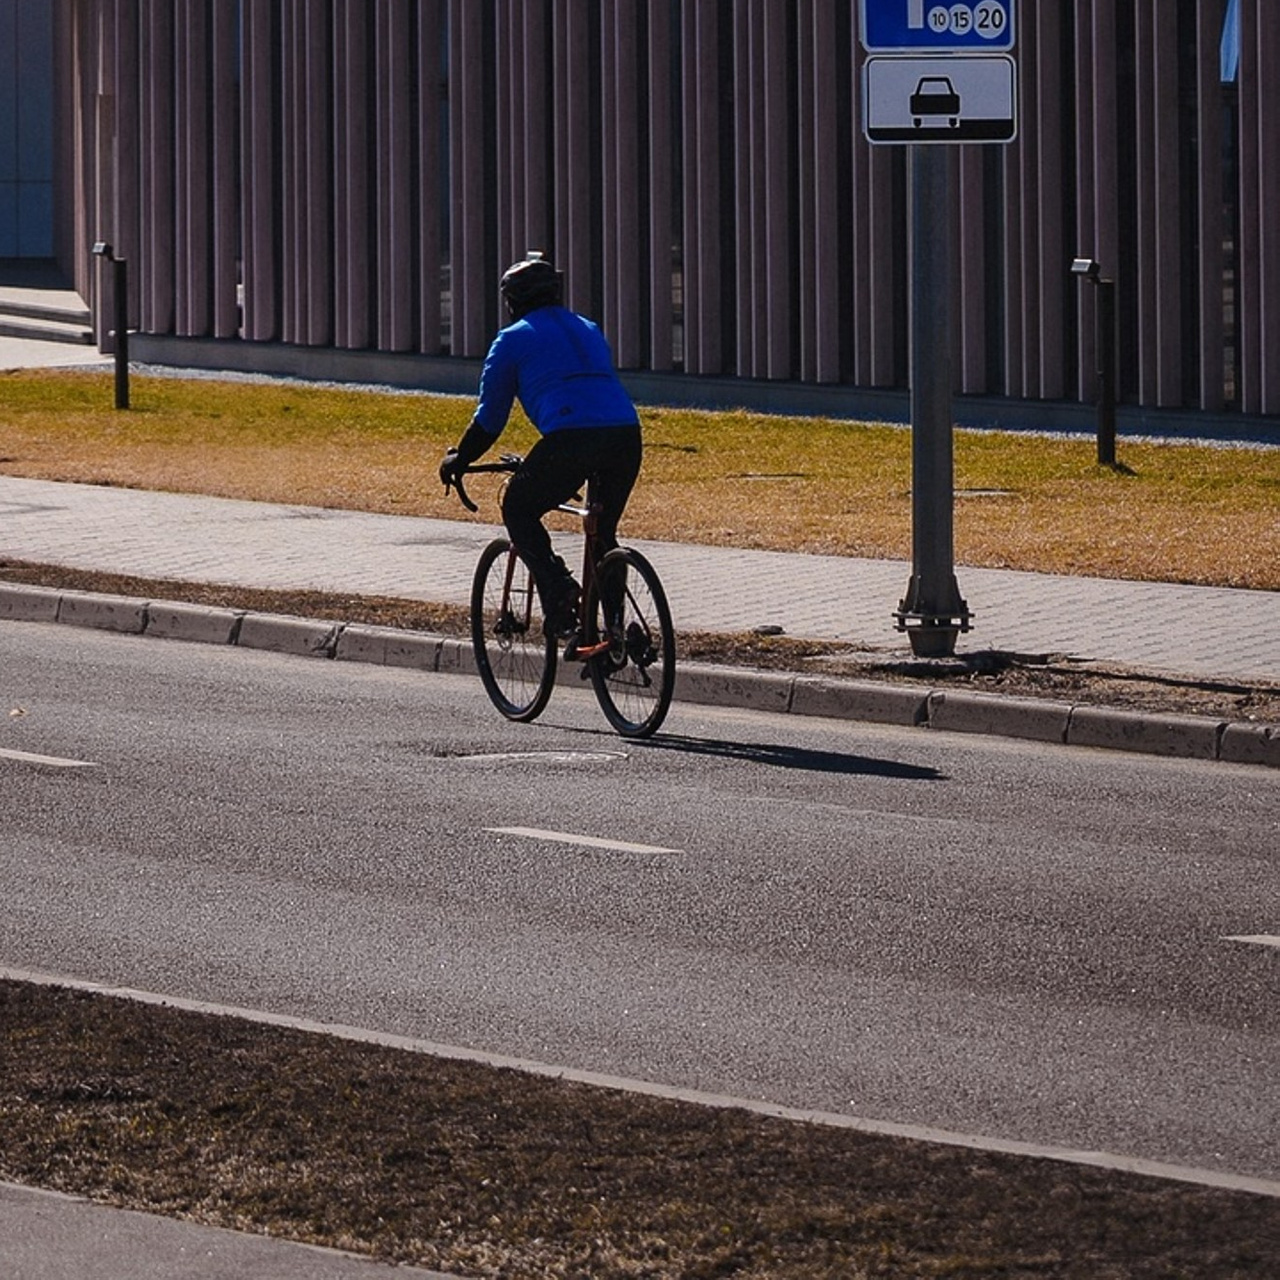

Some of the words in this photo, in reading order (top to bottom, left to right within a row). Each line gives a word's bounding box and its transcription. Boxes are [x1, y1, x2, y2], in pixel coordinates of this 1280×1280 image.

[932, 13, 946, 26] 10
[953, 11, 969, 28] 15
[978, 8, 1003, 29] 20
